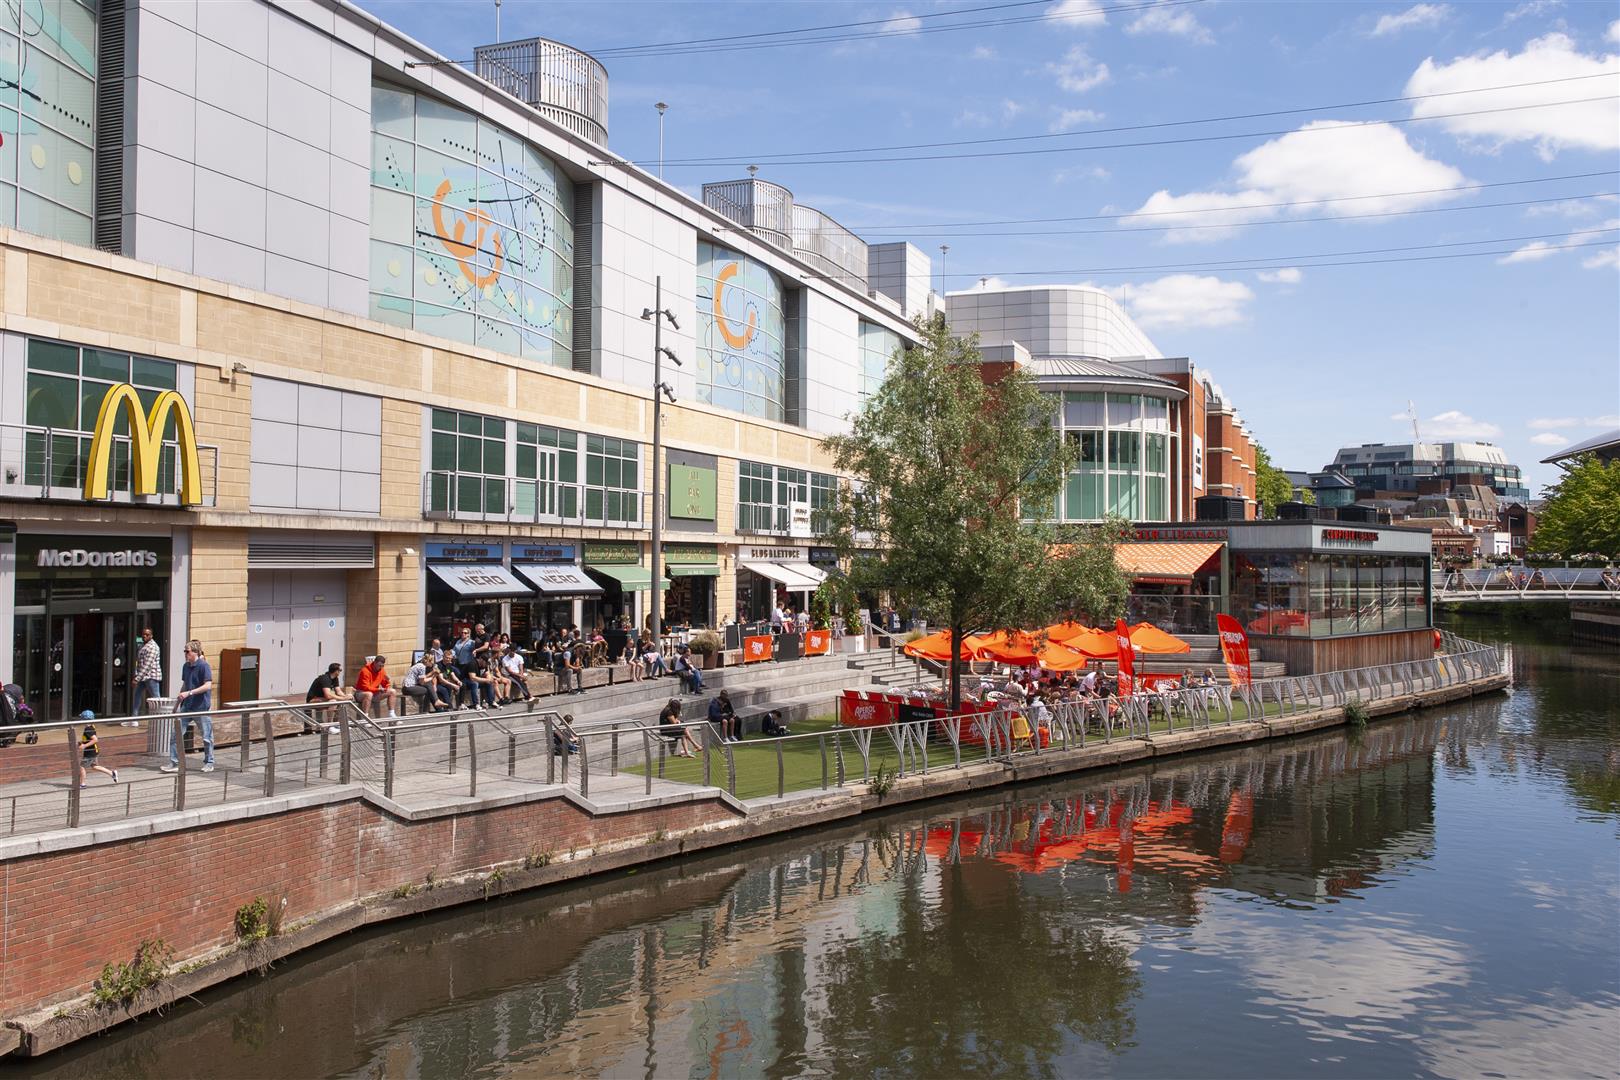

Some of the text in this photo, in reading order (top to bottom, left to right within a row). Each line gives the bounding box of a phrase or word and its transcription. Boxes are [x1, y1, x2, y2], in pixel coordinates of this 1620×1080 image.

[37, 549, 158, 567] McDonald's
[751, 549, 768, 558] SLUG
[774, 549, 800, 558] LETTUCE
[457, 576, 507, 585] NERO
[540, 574, 581, 584] NERO
[854, 705, 876, 716] APEROL
